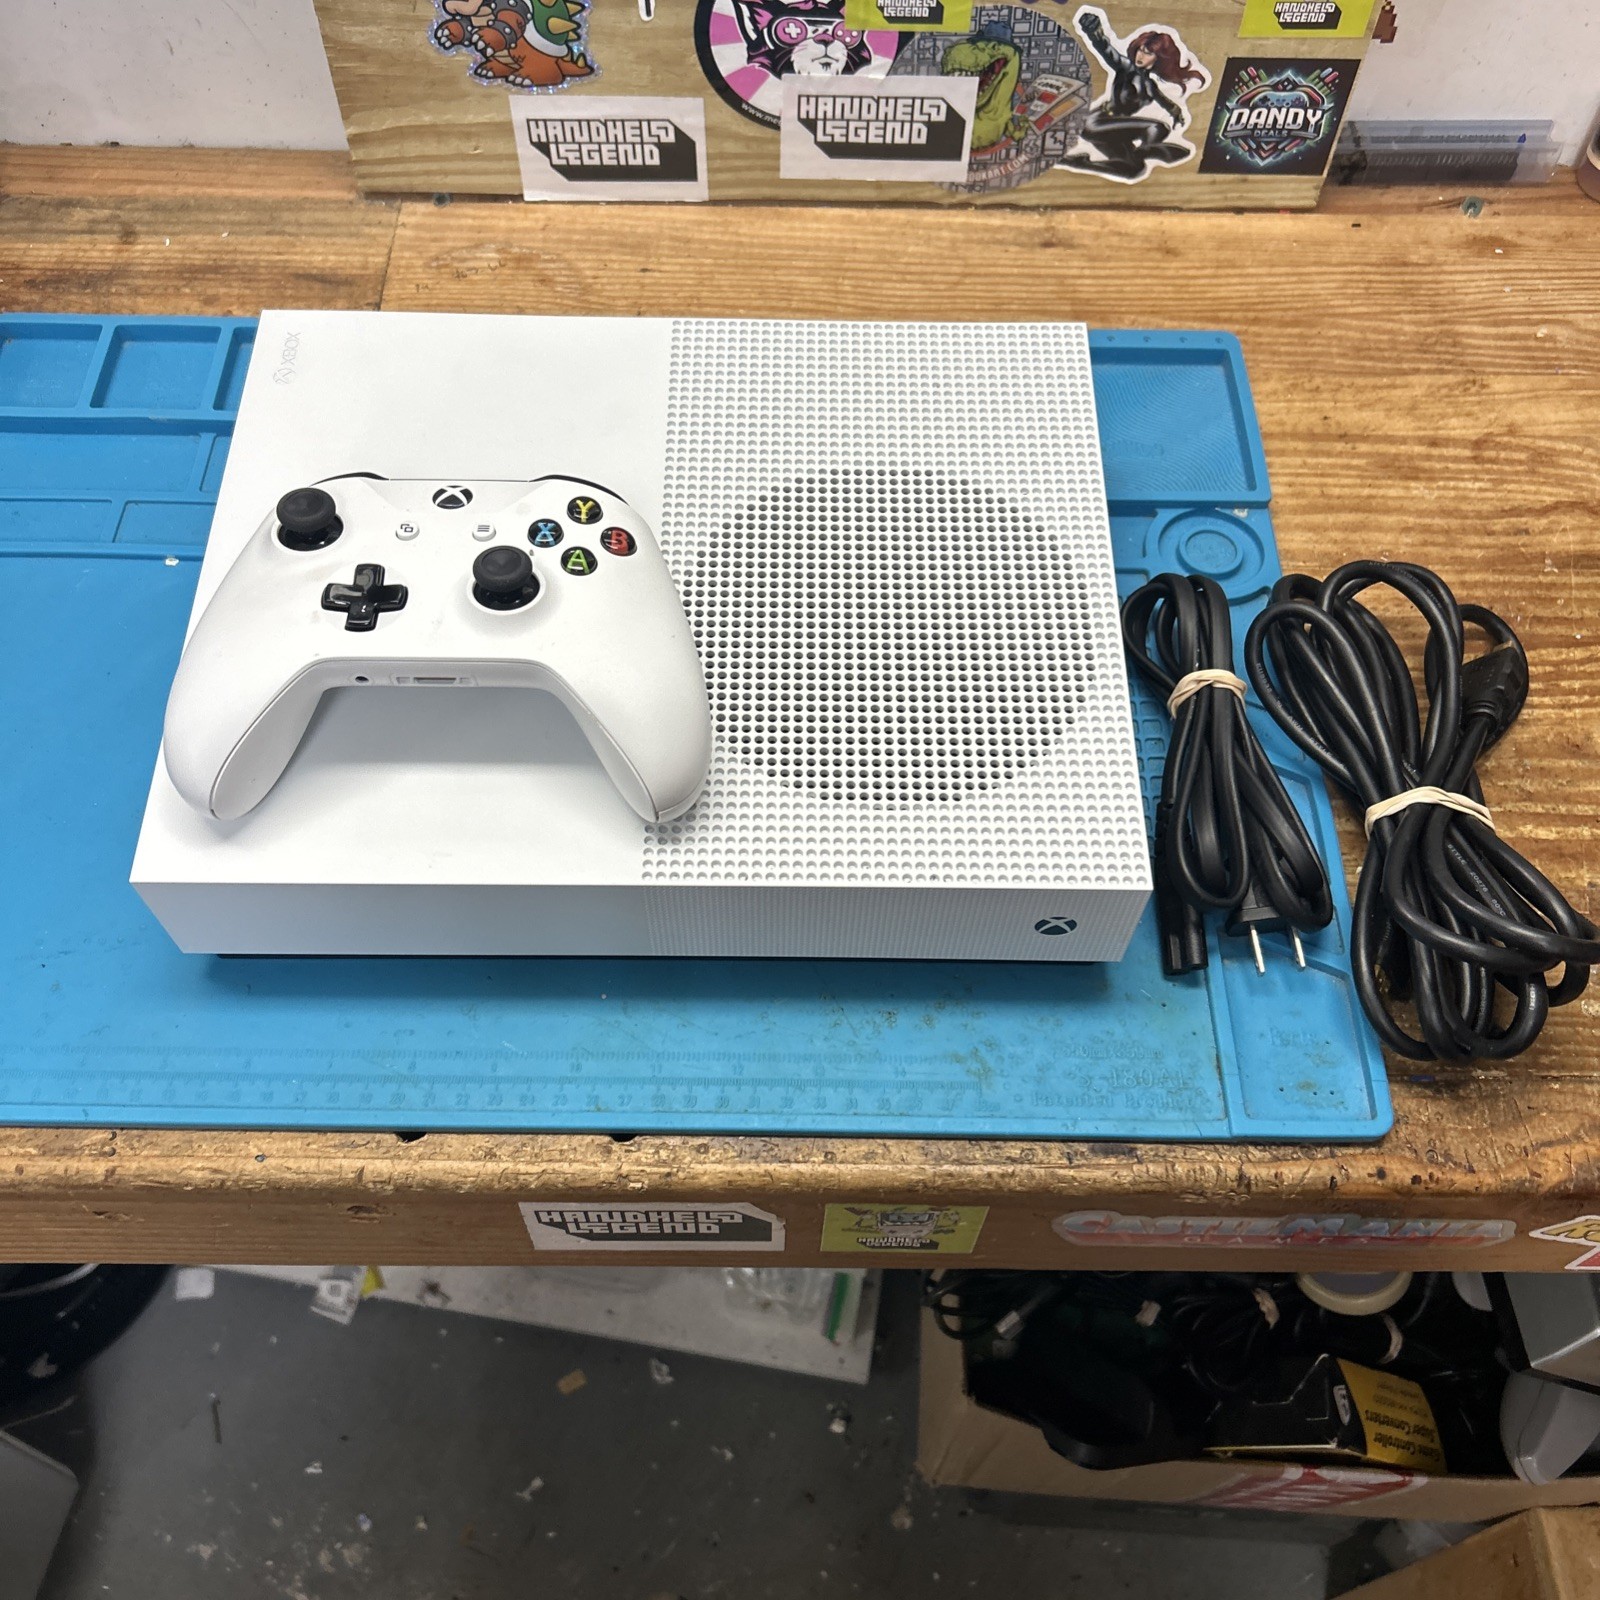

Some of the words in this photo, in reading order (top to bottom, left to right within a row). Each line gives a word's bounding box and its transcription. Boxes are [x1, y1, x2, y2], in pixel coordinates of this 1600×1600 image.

[884, 7, 929, 17] LEGEND
[1274, 3, 1336, 13] HANDHELD
[1279, 12, 1326, 22] LEGEND
[797, 94, 948, 122] HANDHELD
[1226, 107, 1322, 133] DANDY
[527, 119, 676, 144] HANDHELD
[816, 120, 929, 145] LEGEND
[549, 143, 661, 166] LEGEND
[575, 498, 594, 524] Y
[536, 522, 555, 547] X
[610, 530, 631, 554] B
[566, 549, 590, 575] A
[537, 1210, 743, 1223] HANDHELD
[566, 1222, 720, 1234] LEGEND
